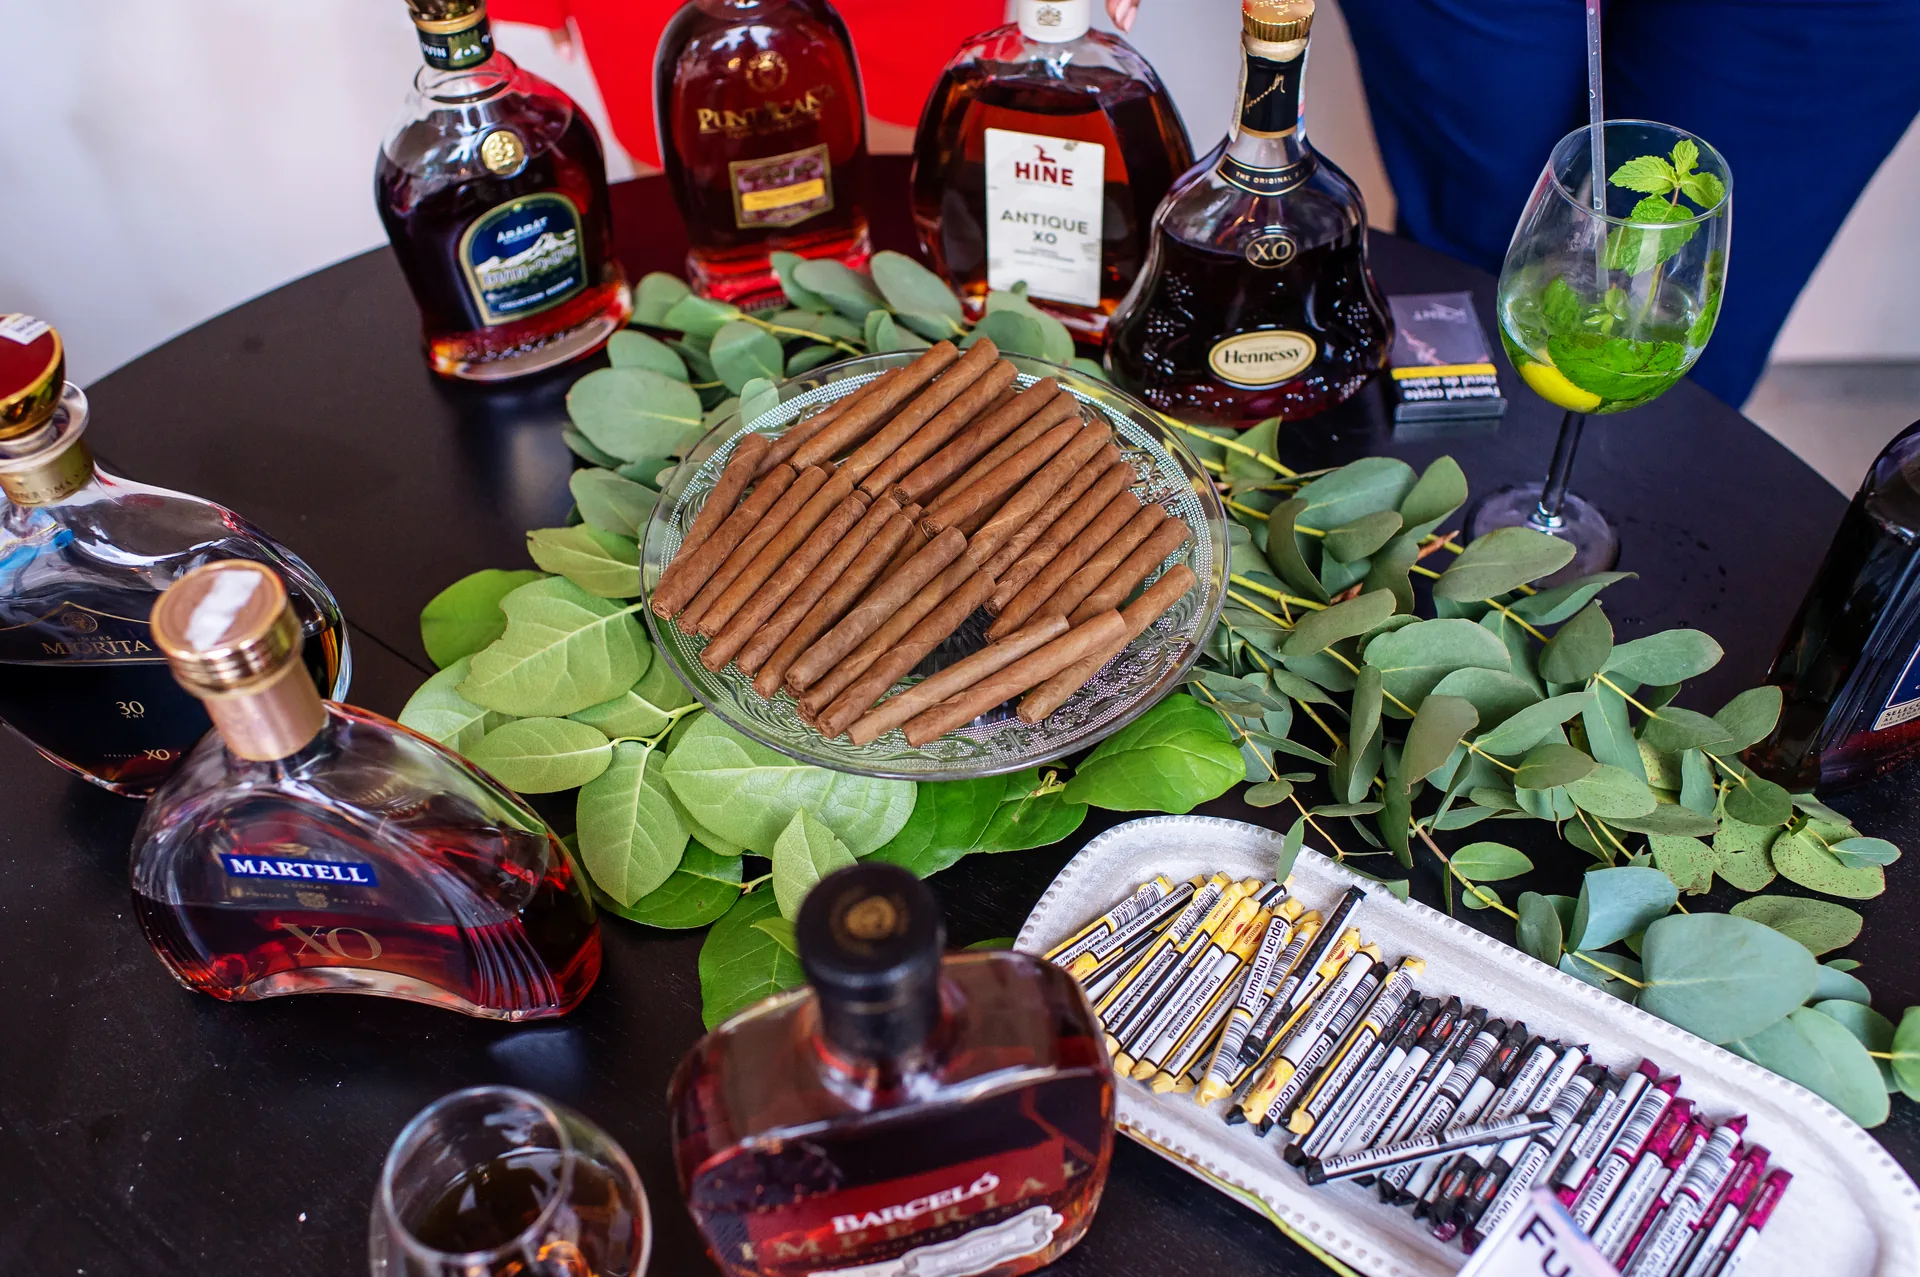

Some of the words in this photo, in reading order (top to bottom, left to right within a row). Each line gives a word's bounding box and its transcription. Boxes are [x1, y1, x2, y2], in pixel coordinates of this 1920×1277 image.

[1015, 161, 1074, 186] HINE
[1001, 209, 1089, 235] ANTIQUE
[1033, 230, 1057, 245] XO
[1224, 348, 1302, 365] Hennessy
[116, 701, 145, 716] 30
[143, 749, 170, 761] XO
[229, 858, 369, 883] MARTELL
[1094, 930, 1126, 955] vasculare
[1124, 909, 1155, 934] cerebrale
[1154, 905, 1163, 915] și
[1160, 883, 1192, 909] infirmitate
[1172, 908, 1193, 931] 833174
[277, 922, 382, 961] XO
[1074, 941, 1088, 953] STOP
[1196, 954, 1217, 976] familiei
[1235, 953, 1273, 1008] Fumatul
[1260, 918, 1287, 954] ucide
[1169, 979, 1196, 1009] prietenilor
[1192, 974, 1221, 1007] Fumatul
[1165, 1004, 1198, 1041] cauzează
[1313, 1018, 1324, 1030] de
[1319, 985, 1351, 1022] impotență
[1136, 1007, 1175, 1052] dumneavoastră
[1296, 1008, 1321, 1038] Fumatul
[1430, 1011, 1452, 1039] CANDLELIGHT
[1289, 1036, 1336, 1086] Fumatul
[1383, 1068, 1394, 1078] 10
[1516, 1049, 1544, 1082] rămâneți
[1364, 1076, 1388, 1106] cancere
[1389, 1065, 1417, 1099] Fumatul
[1521, 1084, 1533, 1097] cei
[1528, 1065, 1547, 1086] dragi
[1532, 1085, 1553, 1110] crește
[1546, 1064, 1565, 1086] riscul
[1265, 1083, 1299, 1119] ucide
[1372, 1095, 1395, 1121] poate
[1494, 1105, 1505, 1116] la
[1499, 1085, 1520, 1108] fumat
[1336, 1103, 1368, 1143] pulmonare
[1358, 1118, 1380, 1144] ucide
[1455, 1110, 1468, 1123] de
[1582, 1130, 1605, 1159] atacuri
[1600, 1119, 1612, 1131] de
[1607, 1096, 1626, 1120] inimă
[1323, 1150, 1367, 1171] ucide
[1370, 1133, 1435, 1162] Fumatul
[1505, 1148, 1549, 1200] Fumatul
[1583, 1157, 1627, 1211] Fumatul
[832, 1171, 1001, 1234] BARCELÓ
[1654, 1200, 1698, 1255] Fumatul
